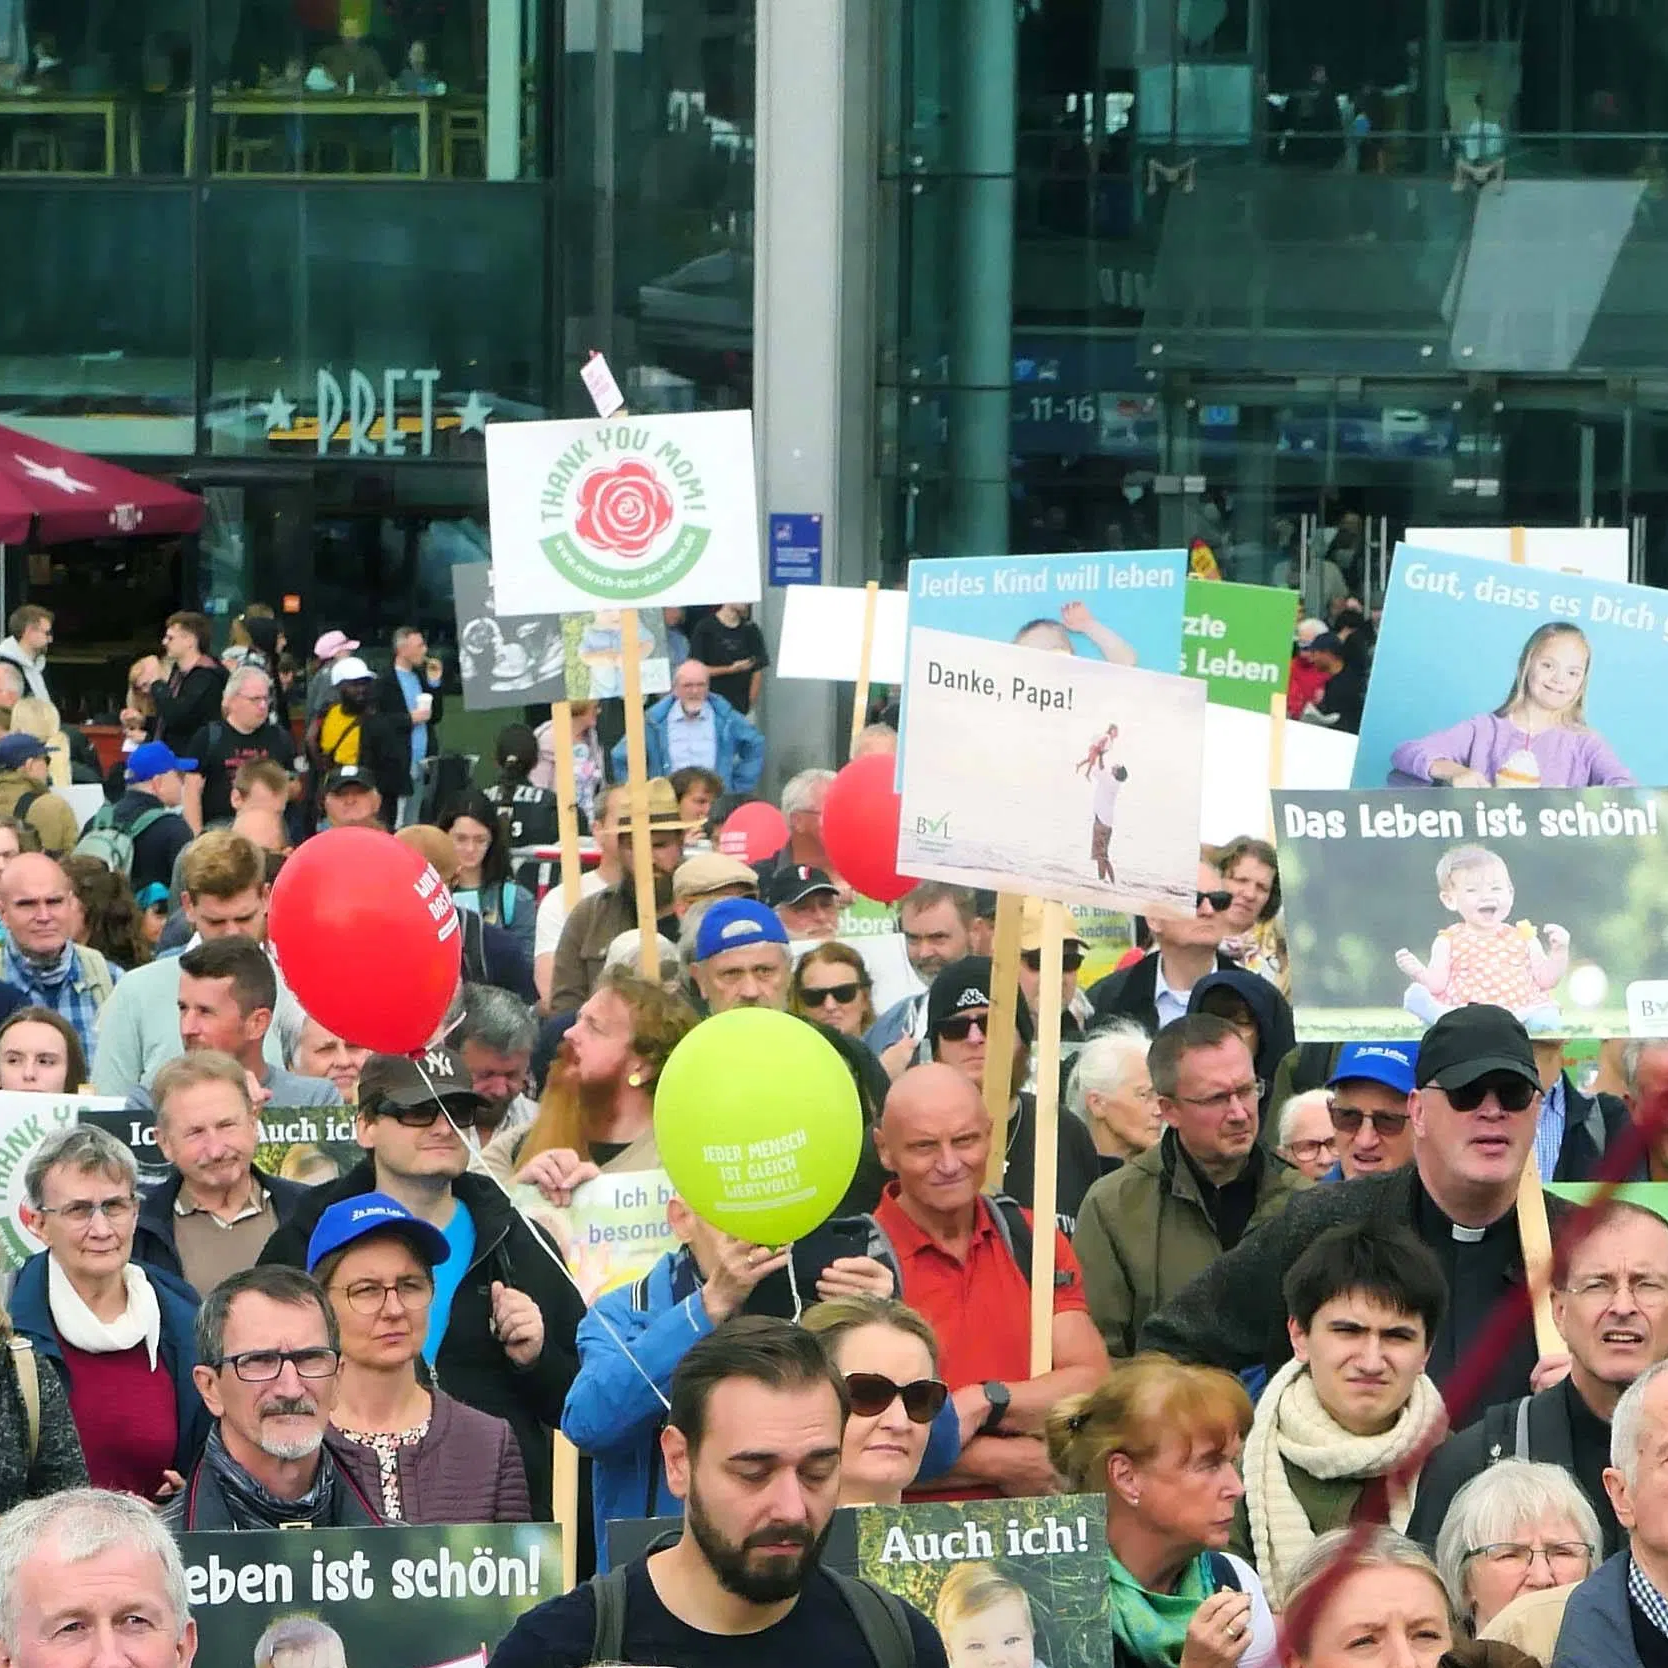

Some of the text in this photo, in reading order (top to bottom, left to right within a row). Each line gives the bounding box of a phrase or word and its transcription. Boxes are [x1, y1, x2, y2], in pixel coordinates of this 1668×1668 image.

[316, 368, 441, 456] PRET
[540, 426, 707, 523] THANK YOU MOM!
[916, 563, 1176, 600] Jedes Kind will leben
[1404, 561, 1466, 601] Gut,
[1474, 575, 1541, 611] dass
[1548, 589, 1582, 619] es
[1589, 595, 1657, 633] Dich
[927, 661, 1074, 712] Danke, Papa!
[1196, 648, 1278, 684] Leben
[1284, 800, 1659, 840] Das Leben ist schön!
[702, 1129, 808, 1164] JEDER MENSCH
[719, 1155, 797, 1182] IST GLEICH
[614, 1186, 648, 1210] Ich
[879, 1516, 1090, 1563] Auch ich!
[184, 1544, 542, 1606] eben ist schön!
